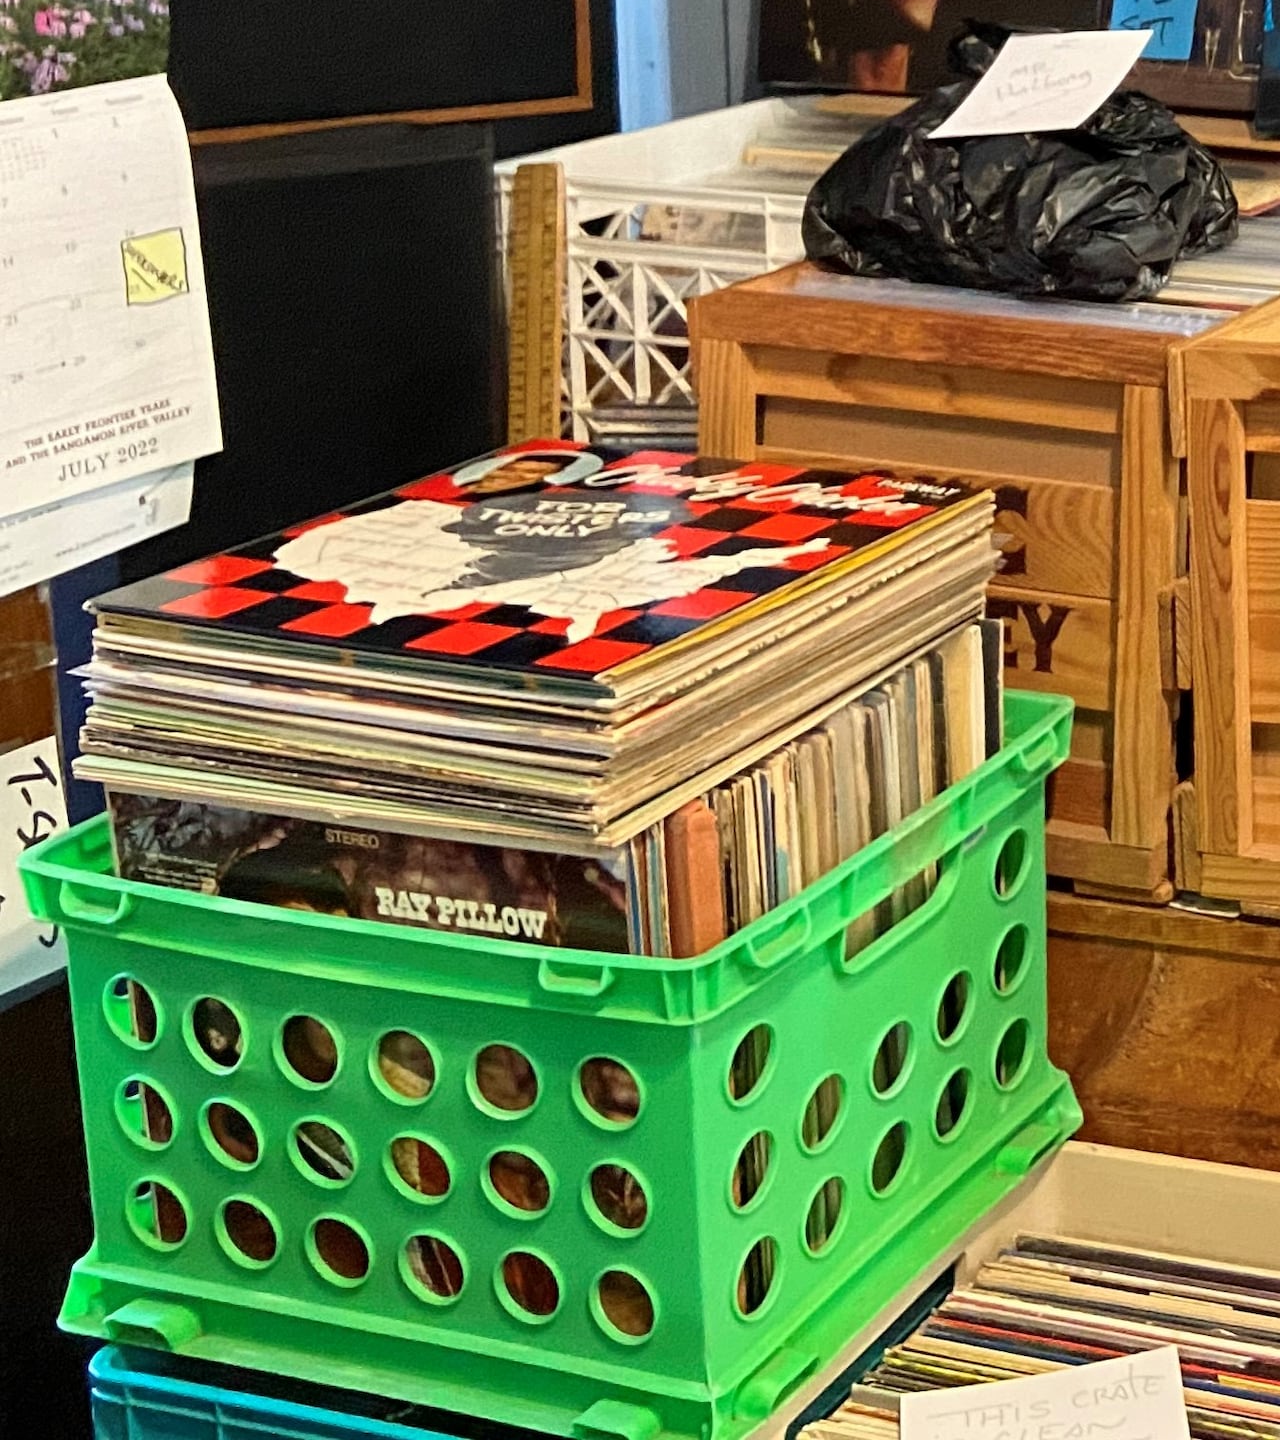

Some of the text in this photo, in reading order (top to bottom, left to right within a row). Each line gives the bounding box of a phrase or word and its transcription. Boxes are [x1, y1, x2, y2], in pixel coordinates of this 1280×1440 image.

[5, 405, 193, 470] AND THE SANGAMON RIVER VALLEY
[24, 397, 171, 450] THE EARLY FRONTIER YEARS
[58, 436, 160, 482] JULY 2022
[478, 507, 671, 526] TWISTERS
[536, 500, 627, 515] FOR
[495, 523, 603, 538] ONLY
[324, 827, 380, 851] STEREO
[375, 887, 548, 940] RAY PILLOW
